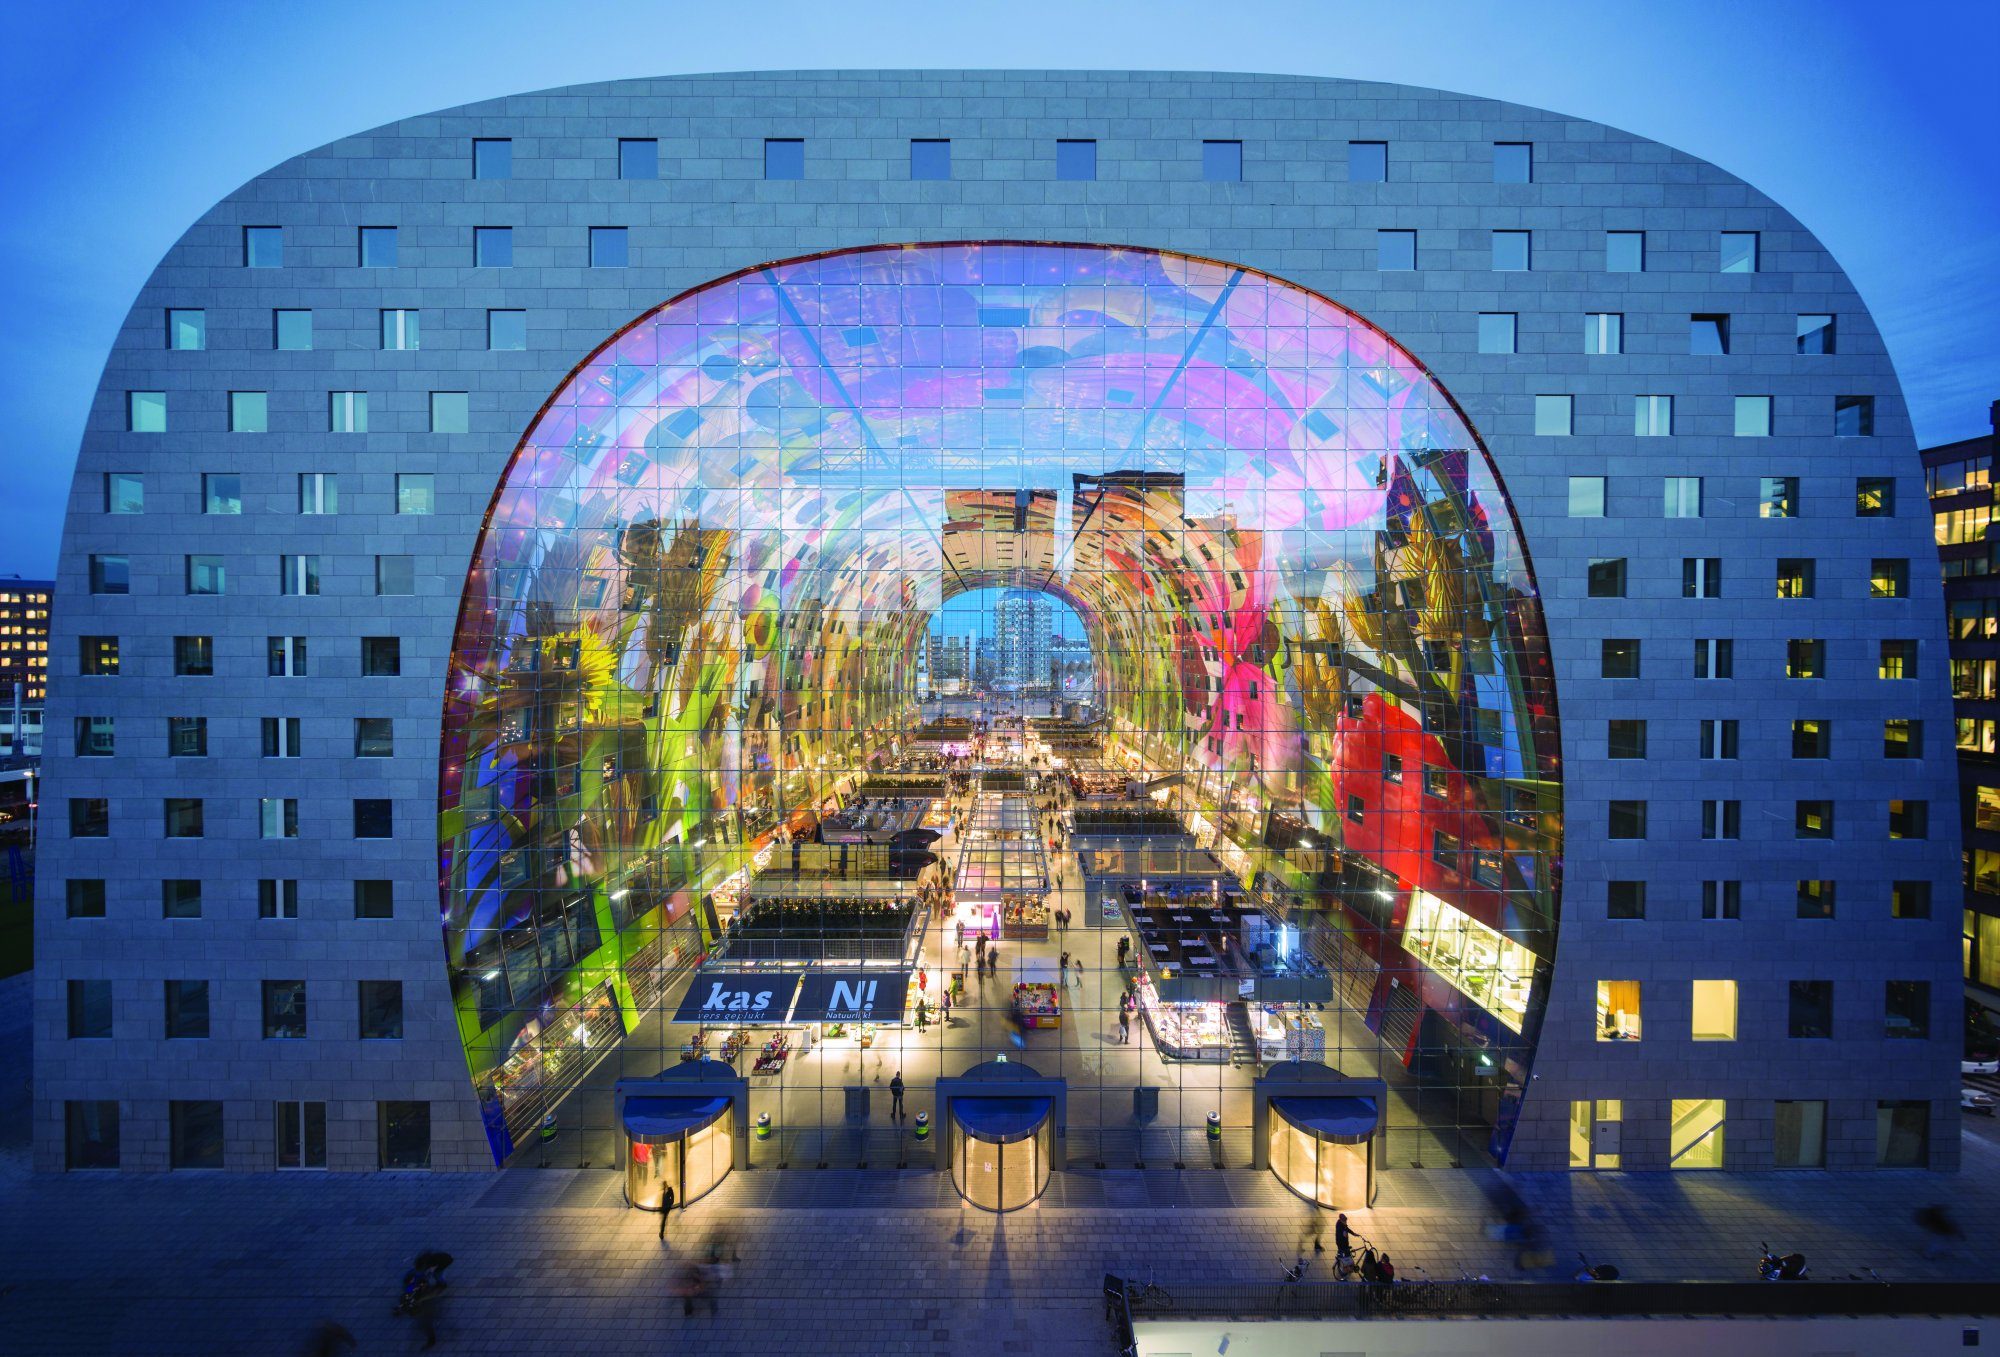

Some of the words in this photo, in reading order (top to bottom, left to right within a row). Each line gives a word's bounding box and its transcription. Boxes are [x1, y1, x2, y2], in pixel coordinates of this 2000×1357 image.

[702, 982, 773, 1011] kas
[828, 980, 878, 1011] N!
[724, 1011, 765, 1021] geplukt
